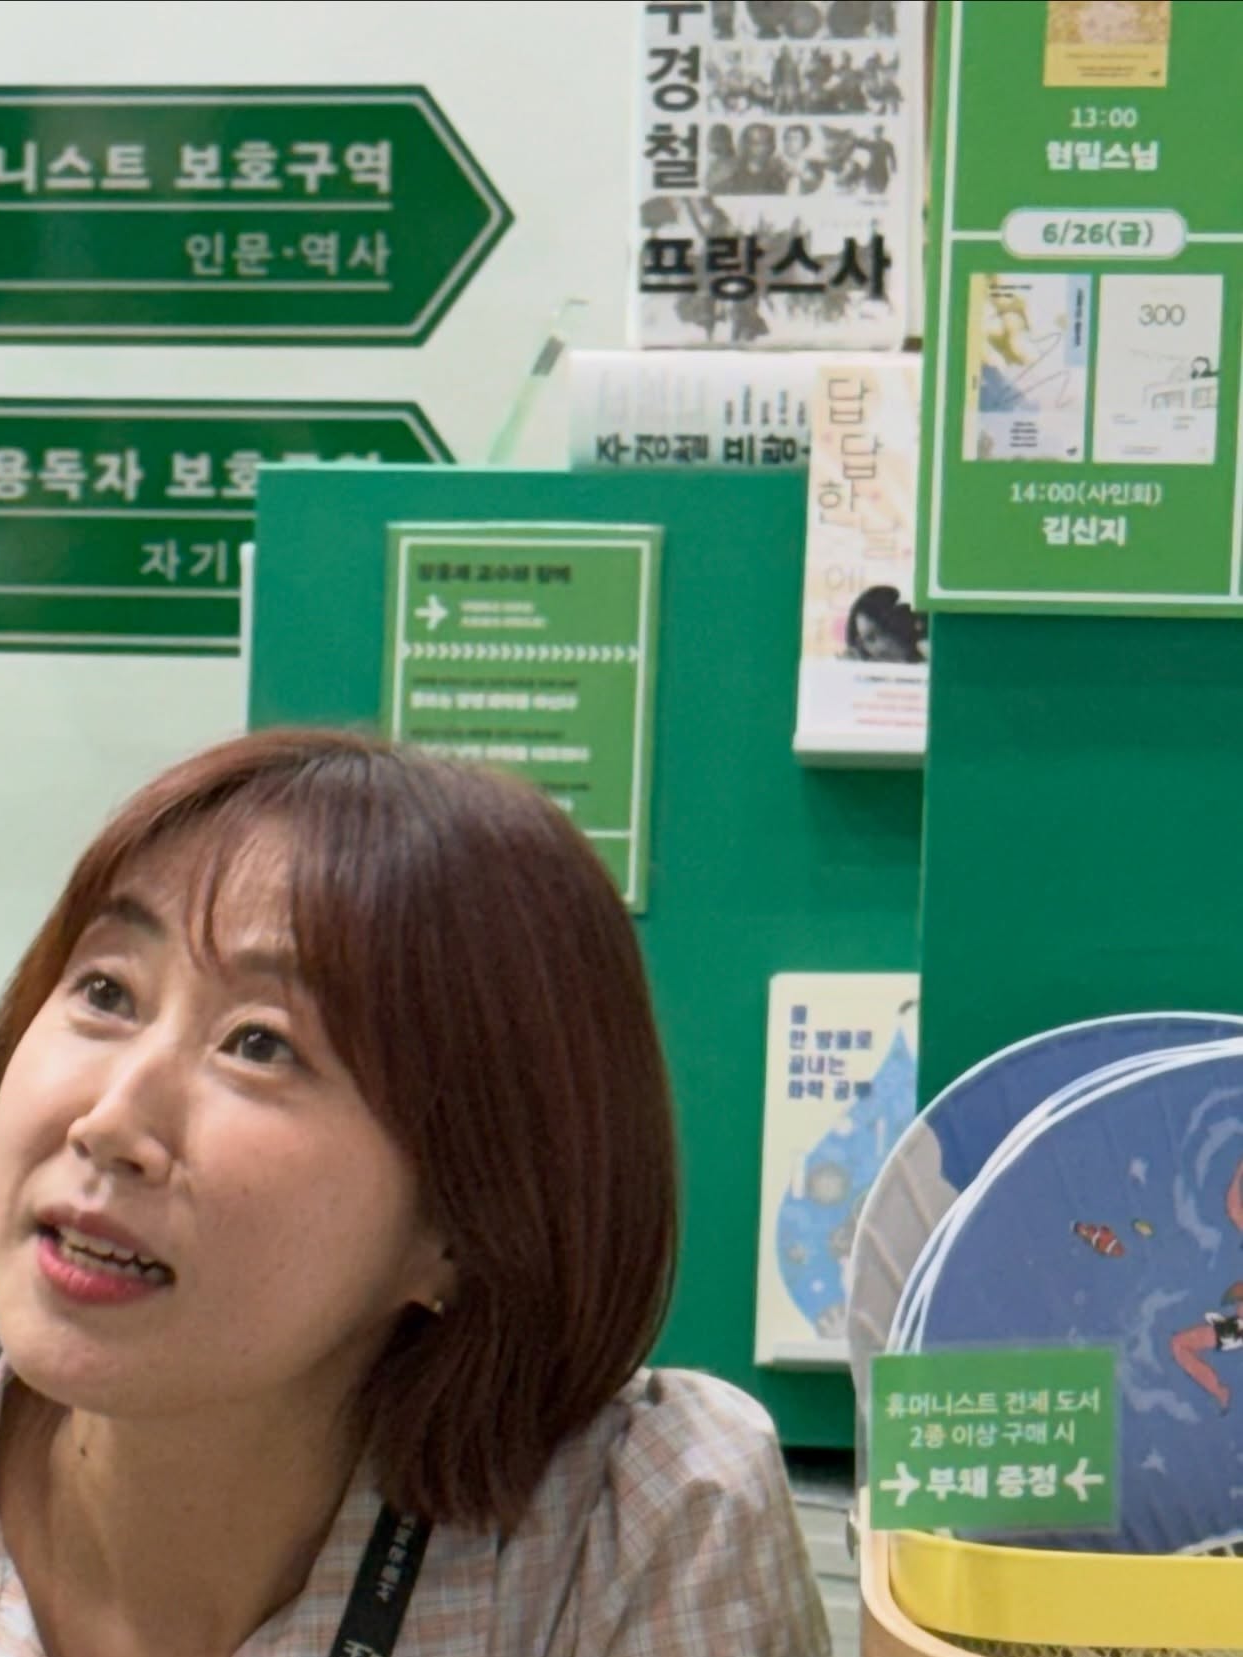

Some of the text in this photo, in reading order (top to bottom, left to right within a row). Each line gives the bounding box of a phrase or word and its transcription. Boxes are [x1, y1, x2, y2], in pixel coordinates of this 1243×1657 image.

[1070, 107, 1139, 129] 13:00
[173, 139, 393, 194] 보호구역
[1041, 220, 1154, 247] 6/26(금)
[185, 231, 392, 276] 인문·역사
[639, 233, 892, 300] 프랑스사
[1138, 303, 1186, 327] 300
[1042, 514, 1128, 547] 김신지
[884, 1387, 1100, 1418] 휴머니스트 전체 도서
[909, 1419, 1076, 1450] 2종 이상 구매 시
[925, 1462, 1058, 1501] 부채 증정
